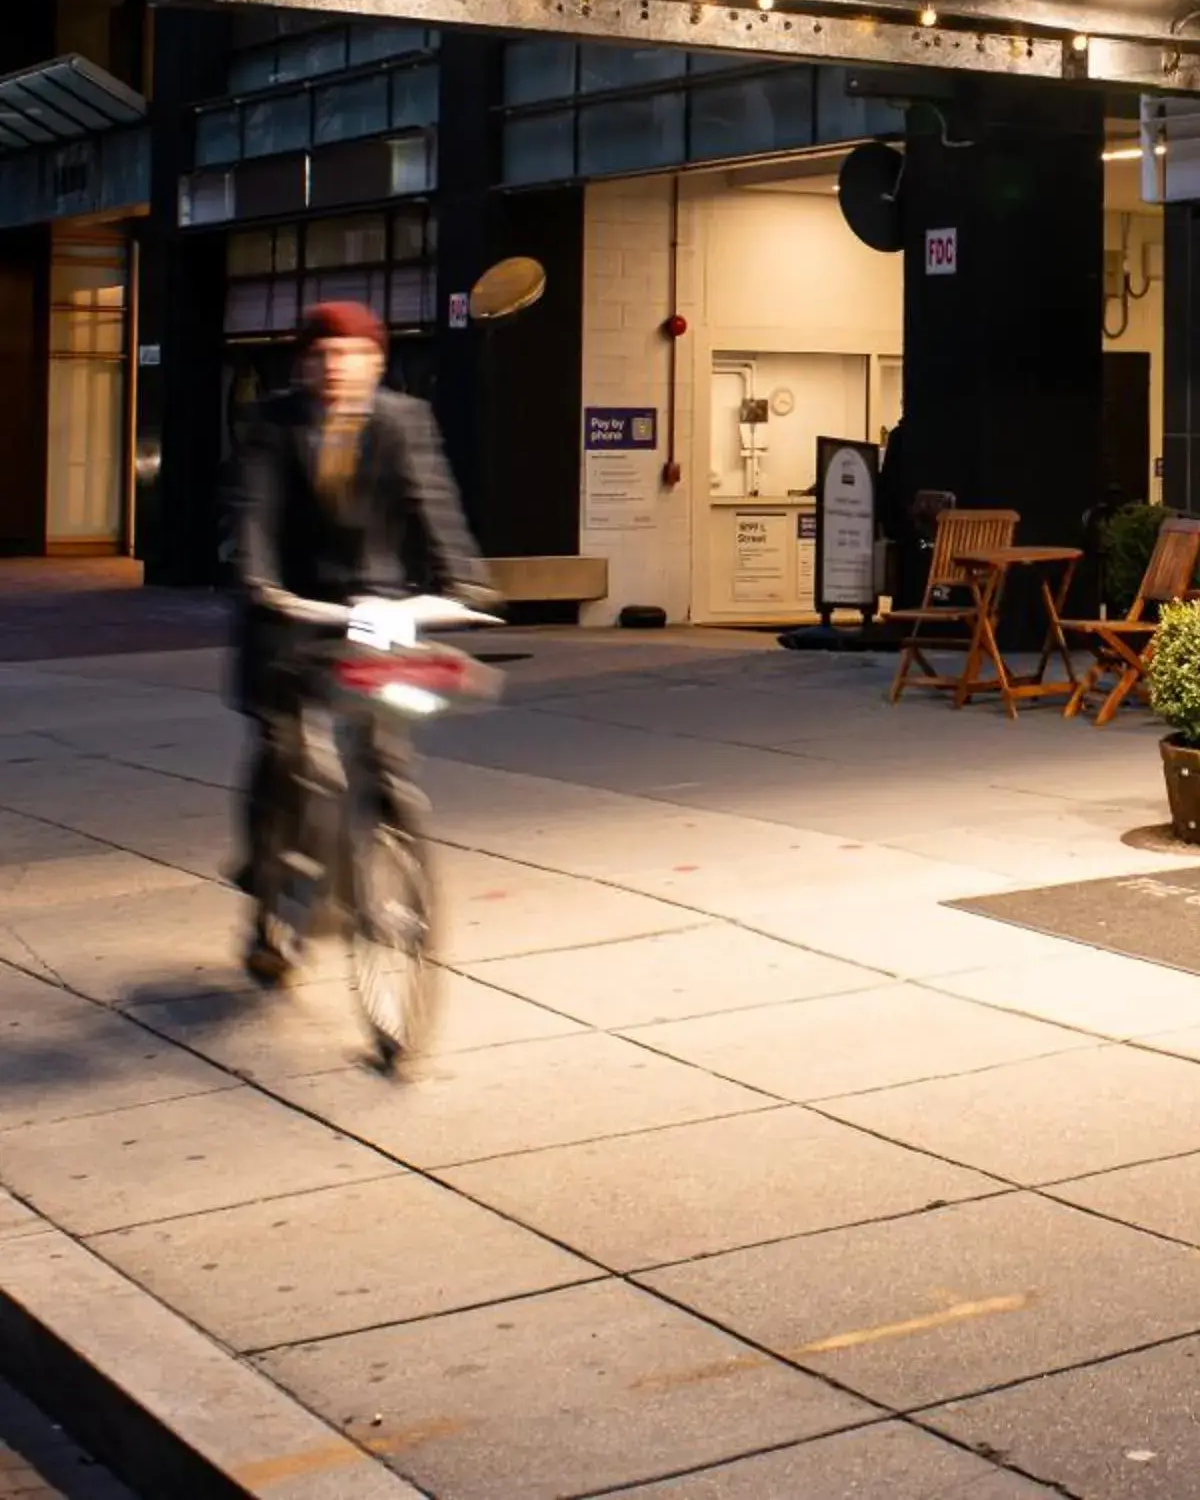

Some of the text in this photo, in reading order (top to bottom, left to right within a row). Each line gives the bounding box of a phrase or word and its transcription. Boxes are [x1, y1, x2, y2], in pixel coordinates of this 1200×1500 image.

[929, 238, 953, 267] FDC
[591, 417, 625, 430] Pay by
[591, 430, 623, 442] phone
[1116, 878, 1197, 897] THE
